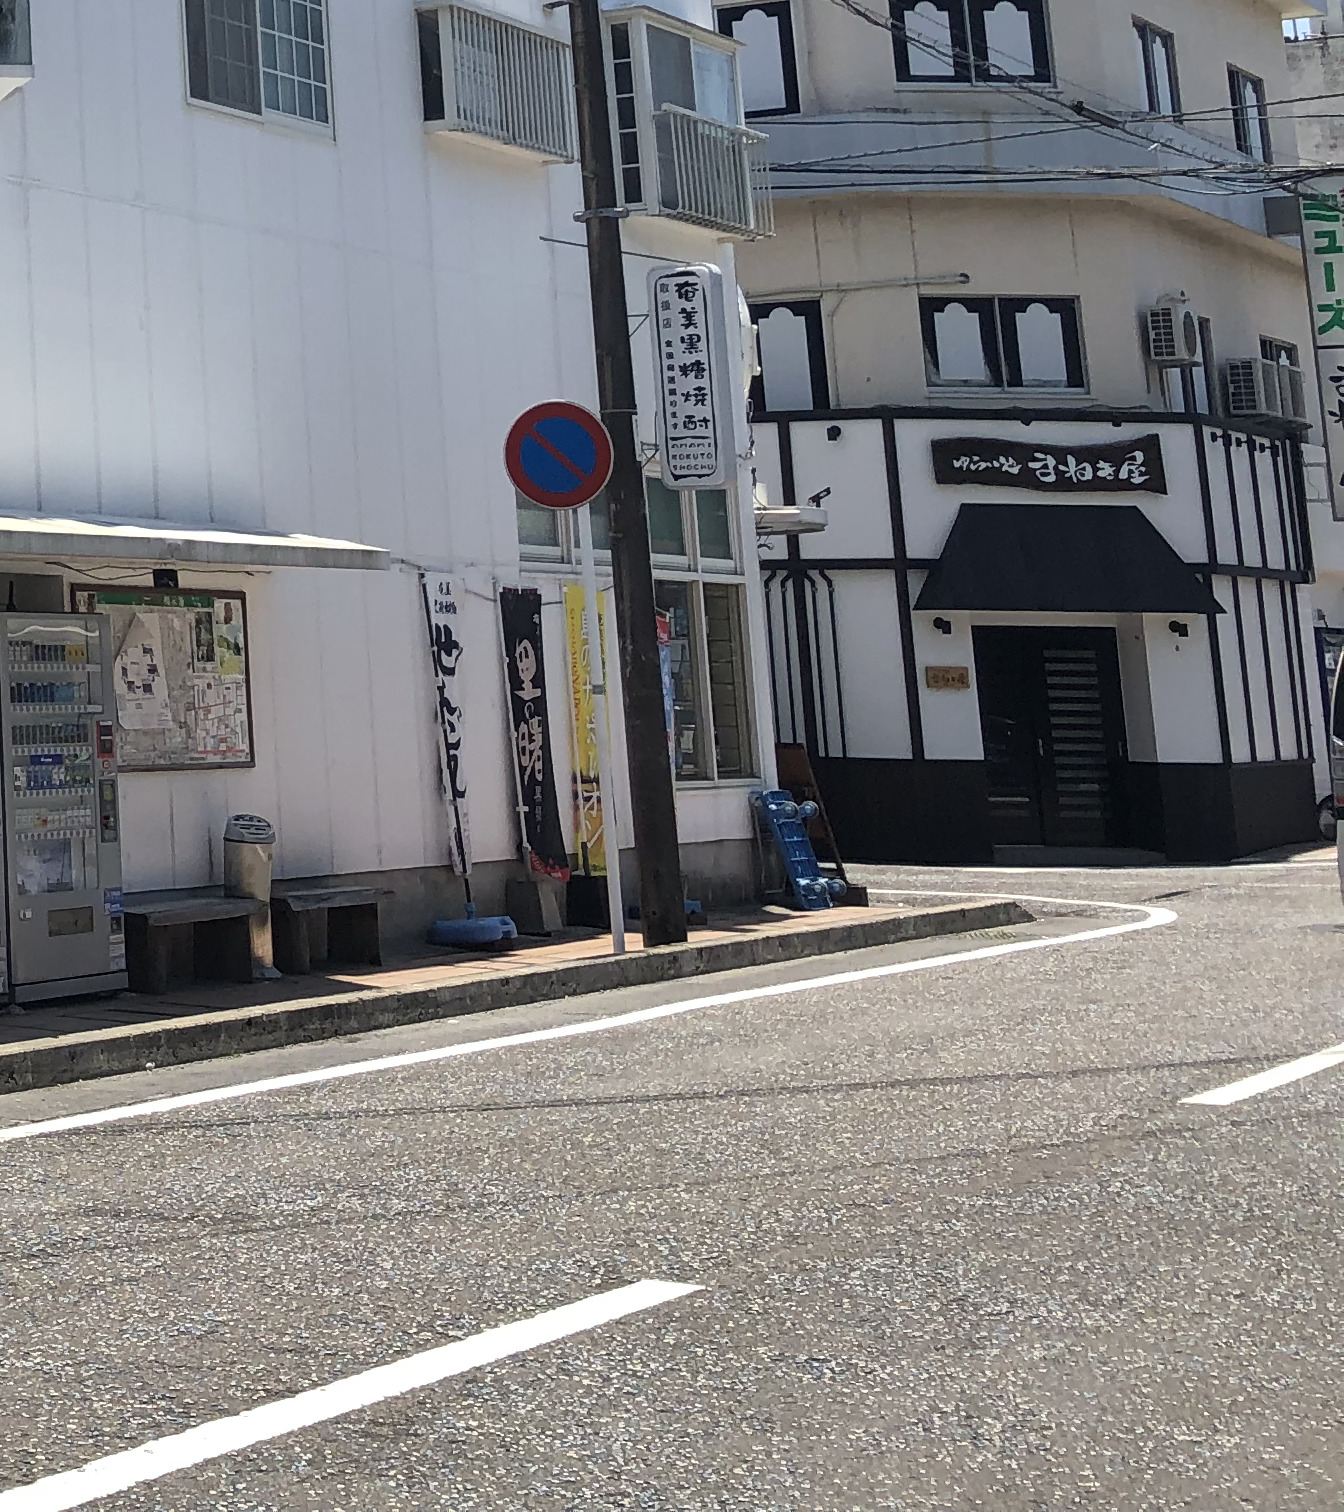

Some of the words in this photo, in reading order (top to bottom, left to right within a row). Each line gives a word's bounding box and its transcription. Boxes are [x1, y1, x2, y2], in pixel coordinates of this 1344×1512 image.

[674, 280, 711, 431] 奄美黒糖焼酎
[1028, 450, 1151, 484] まねき屋
